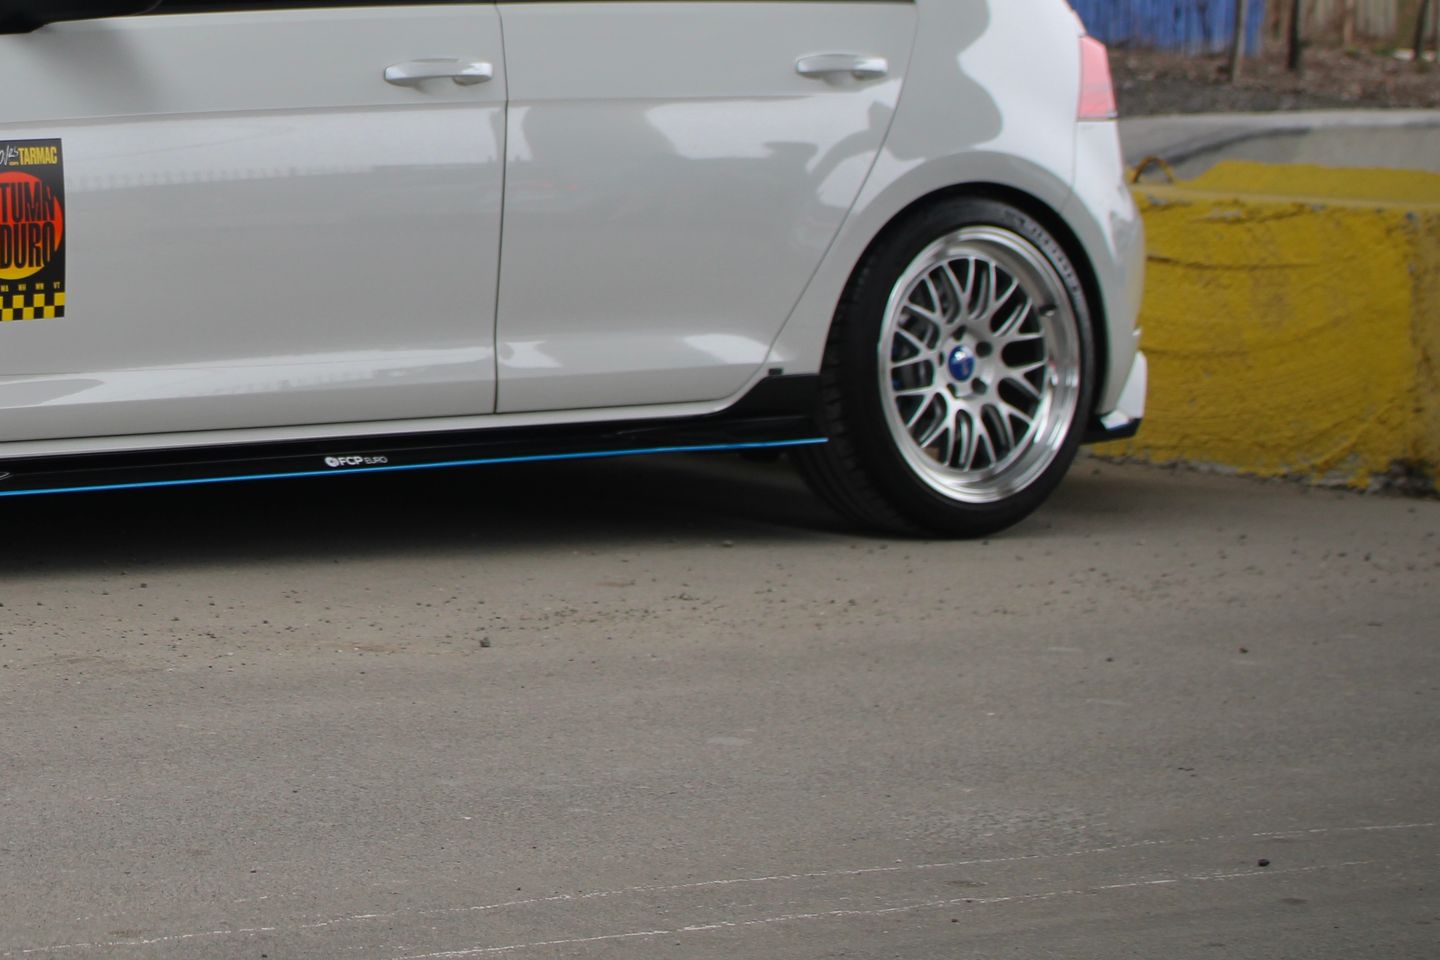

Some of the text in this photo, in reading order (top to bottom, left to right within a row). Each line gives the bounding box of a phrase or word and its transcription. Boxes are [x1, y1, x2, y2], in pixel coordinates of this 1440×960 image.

[17, 145, 58, 165] TARMAC
[52, 281, 61, 289] VT
[338, 455, 363, 466] FCP
